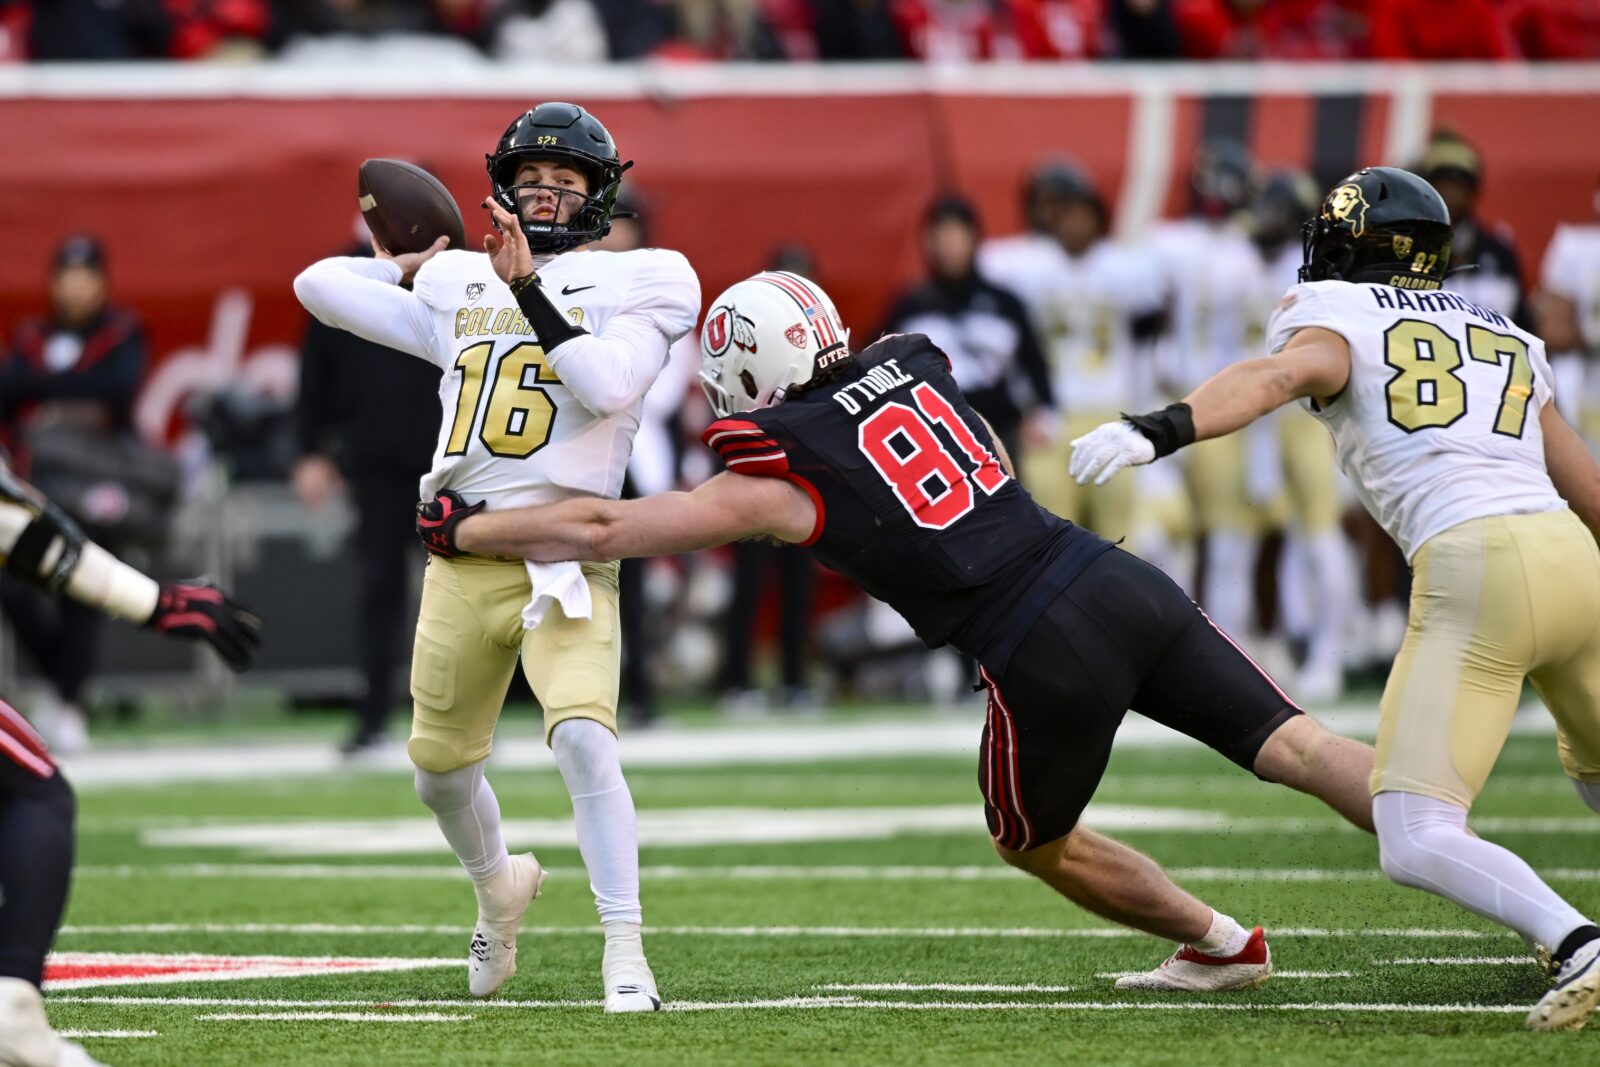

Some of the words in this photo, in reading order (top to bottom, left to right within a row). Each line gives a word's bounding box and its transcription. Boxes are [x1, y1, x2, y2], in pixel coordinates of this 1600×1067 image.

[1410, 252, 1438, 274] 87
[1369, 286, 1510, 330] HARRISON
[707, 311, 727, 352] U
[817, 346, 850, 369] UTES
[1383, 318, 1535, 440] 87
[443, 340, 564, 460] 16
[858, 381, 1010, 530] 81
